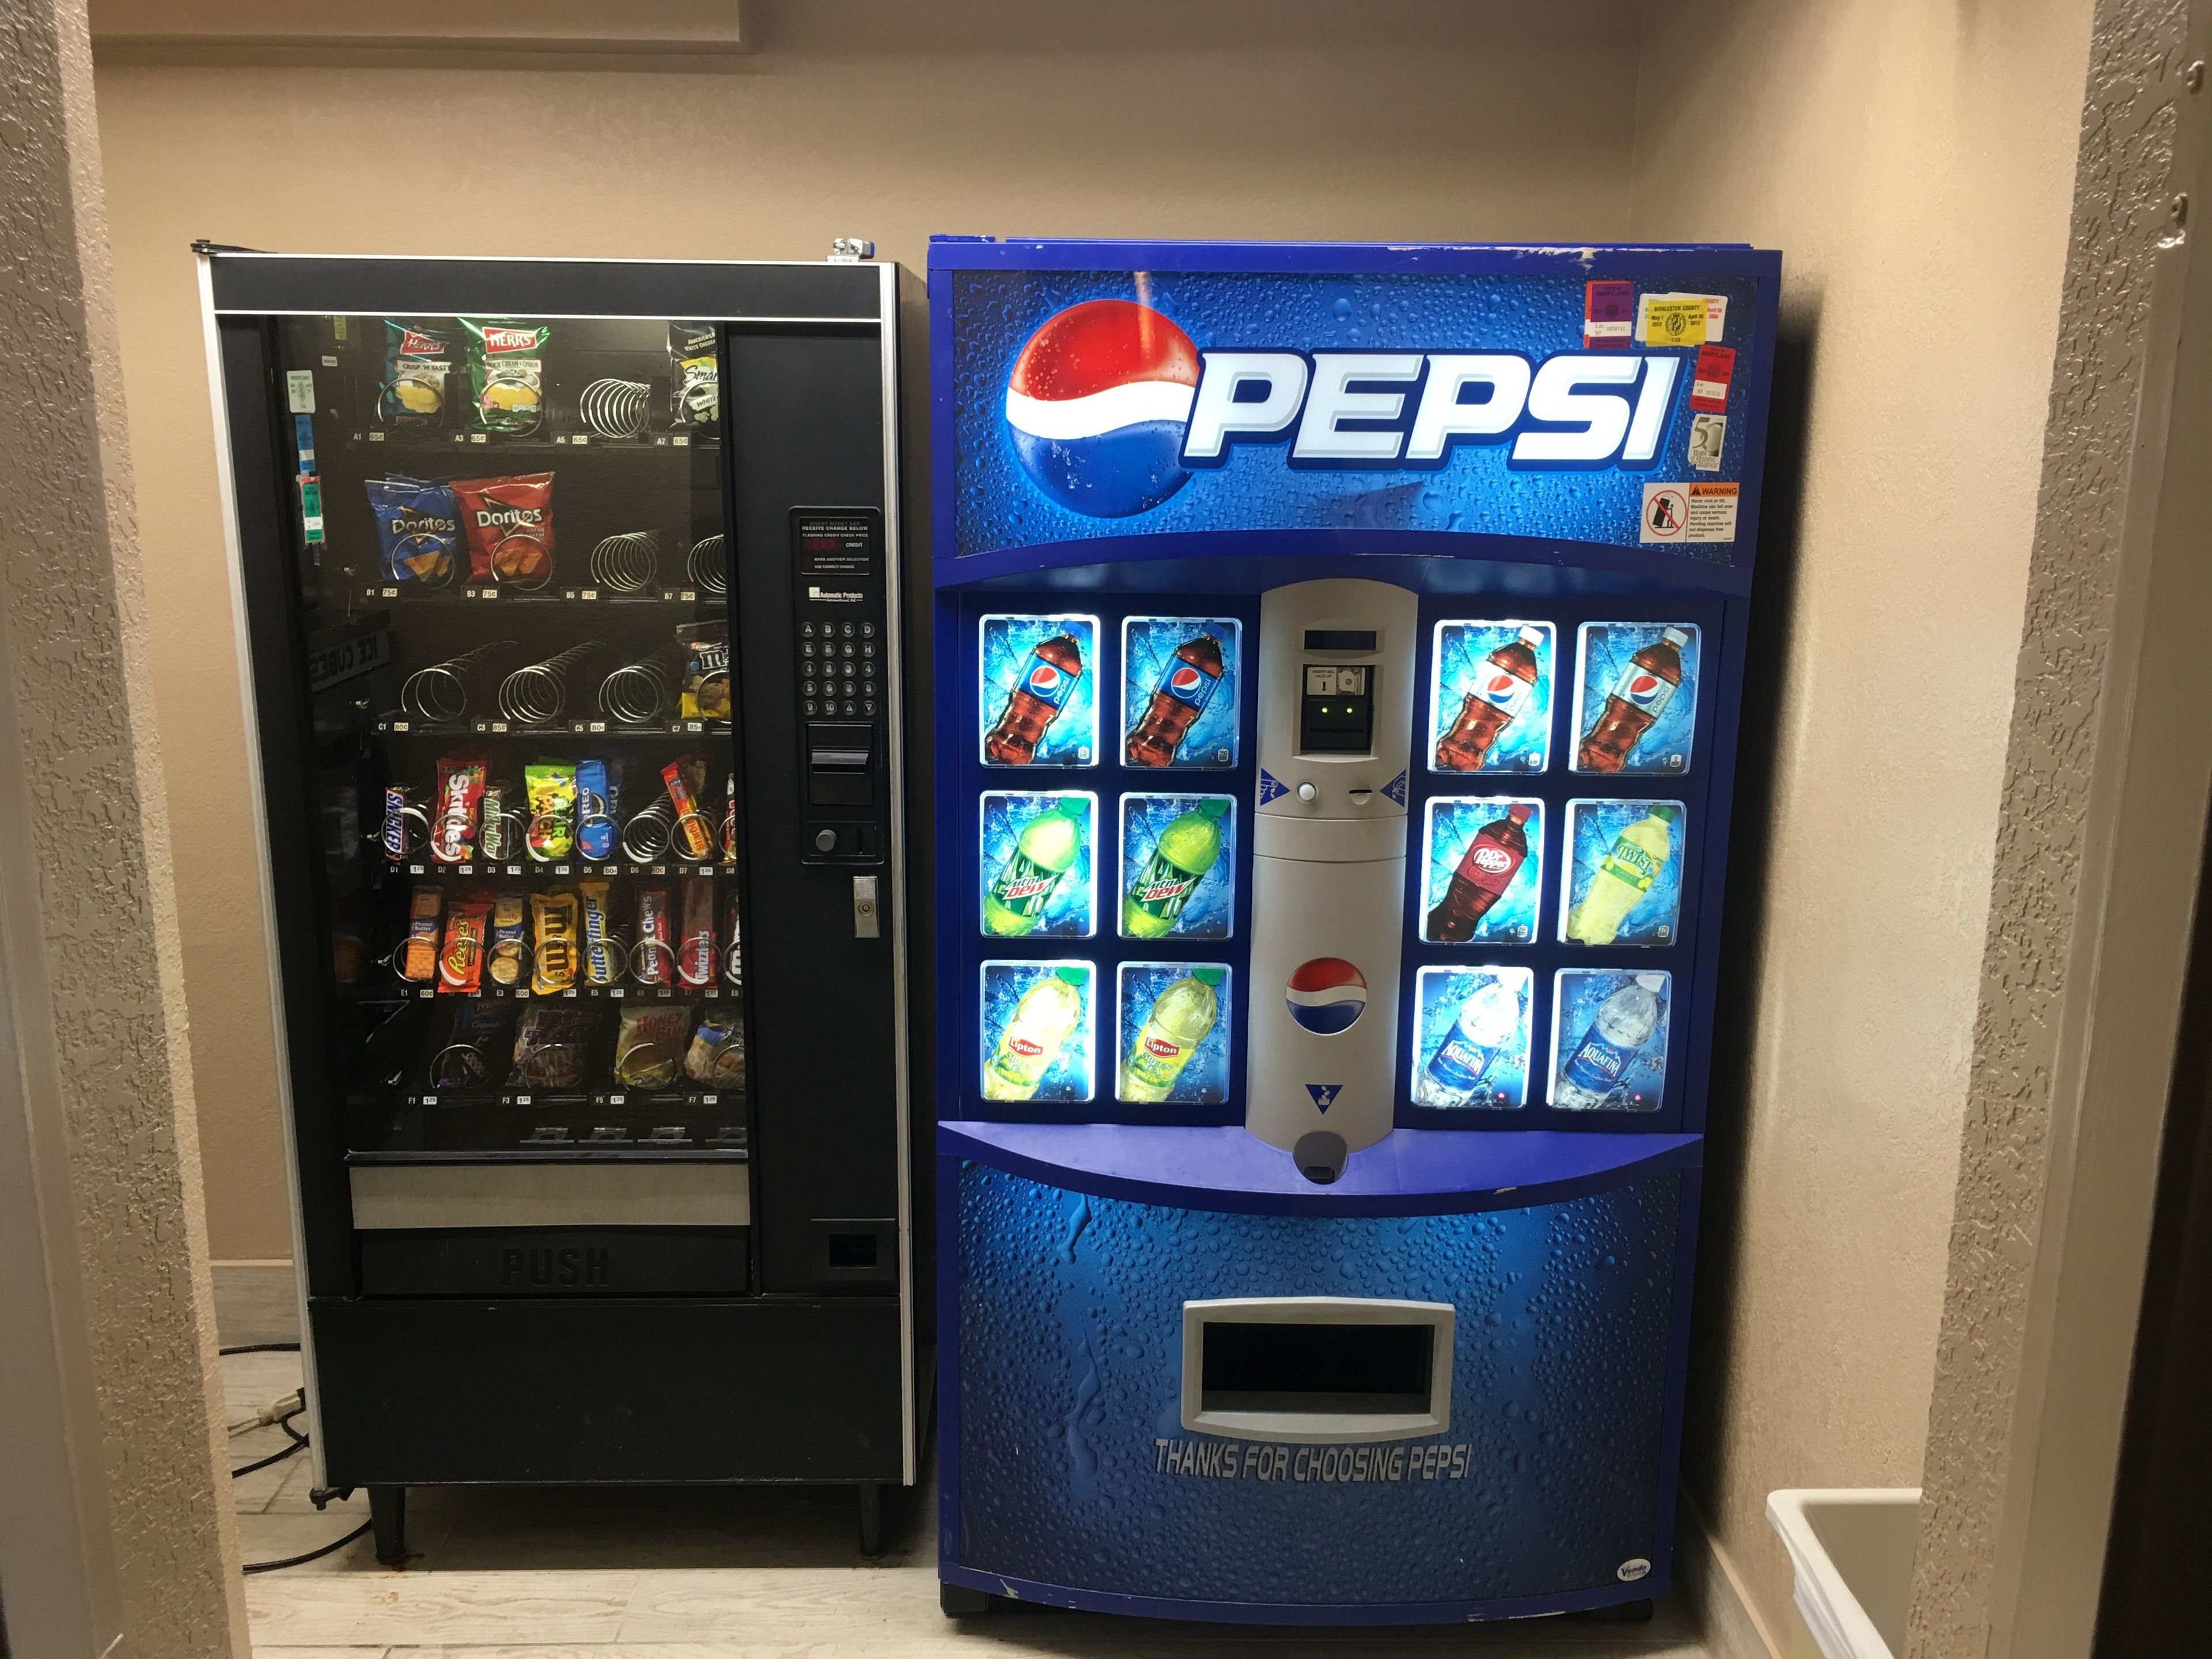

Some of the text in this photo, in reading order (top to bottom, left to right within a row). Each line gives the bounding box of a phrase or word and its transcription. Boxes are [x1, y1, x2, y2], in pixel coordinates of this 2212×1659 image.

[490, 333, 531, 347] HERR'S
[1702, 350, 1732, 359] MARYLAND
[502, 360, 519, 368] CREAM
[683, 365, 718, 385] Smar
[696, 396, 716, 407] WHITE
[1183, 353, 1680, 460] PEPSI
[1693, 449, 1707, 457] YEARS
[1702, 487, 1737, 495] WARNING
[392, 518, 455, 535] Doritos
[476, 509, 542, 527] Doritos
[805, 625, 812, 633] A
[825, 625, 831, 633] B
[844, 625, 851, 634] C
[865, 626, 871, 634] D
[844, 645, 852, 653] G
[865, 645, 872, 653] H
[845, 665, 851, 673] 3
[865, 665, 872, 673] 4
[827, 684, 832, 692] 6
[1053, 676, 1071, 705] pepsi
[1194, 677, 1211, 706] pepsi
[1652, 685, 1671, 713] pepsi
[445, 774, 470, 856] Skittles
[484, 798, 501, 833] Milky
[582, 787, 593, 828] OREO
[387, 792, 404, 851] SNICKER
[1475, 848, 1507, 869] Pepper
[1489, 850, 1503, 861] Dr
[1617, 844, 1653, 872] TWIST
[642, 896, 655, 933] Chews
[586, 896, 608, 982] Butterfinger
[636, 1013, 683, 1035] HONEY
[654, 1025, 686, 1043] BUN
[1010, 1037, 1041, 1054] Lipton
[1146, 1038, 1176, 1054] Lipton
[1141, 1051, 1172, 1071] GREEN
[1441, 1039, 1484, 1075] AQUAFINA
[1578, 1041, 1622, 1077] AQUAFINA
[502, 1248, 608, 1287] PUSH
[1155, 1438, 1472, 1482] THANKS FOR CHOOSING PEPSI
[1621, 1564, 1647, 1577] Vendo
